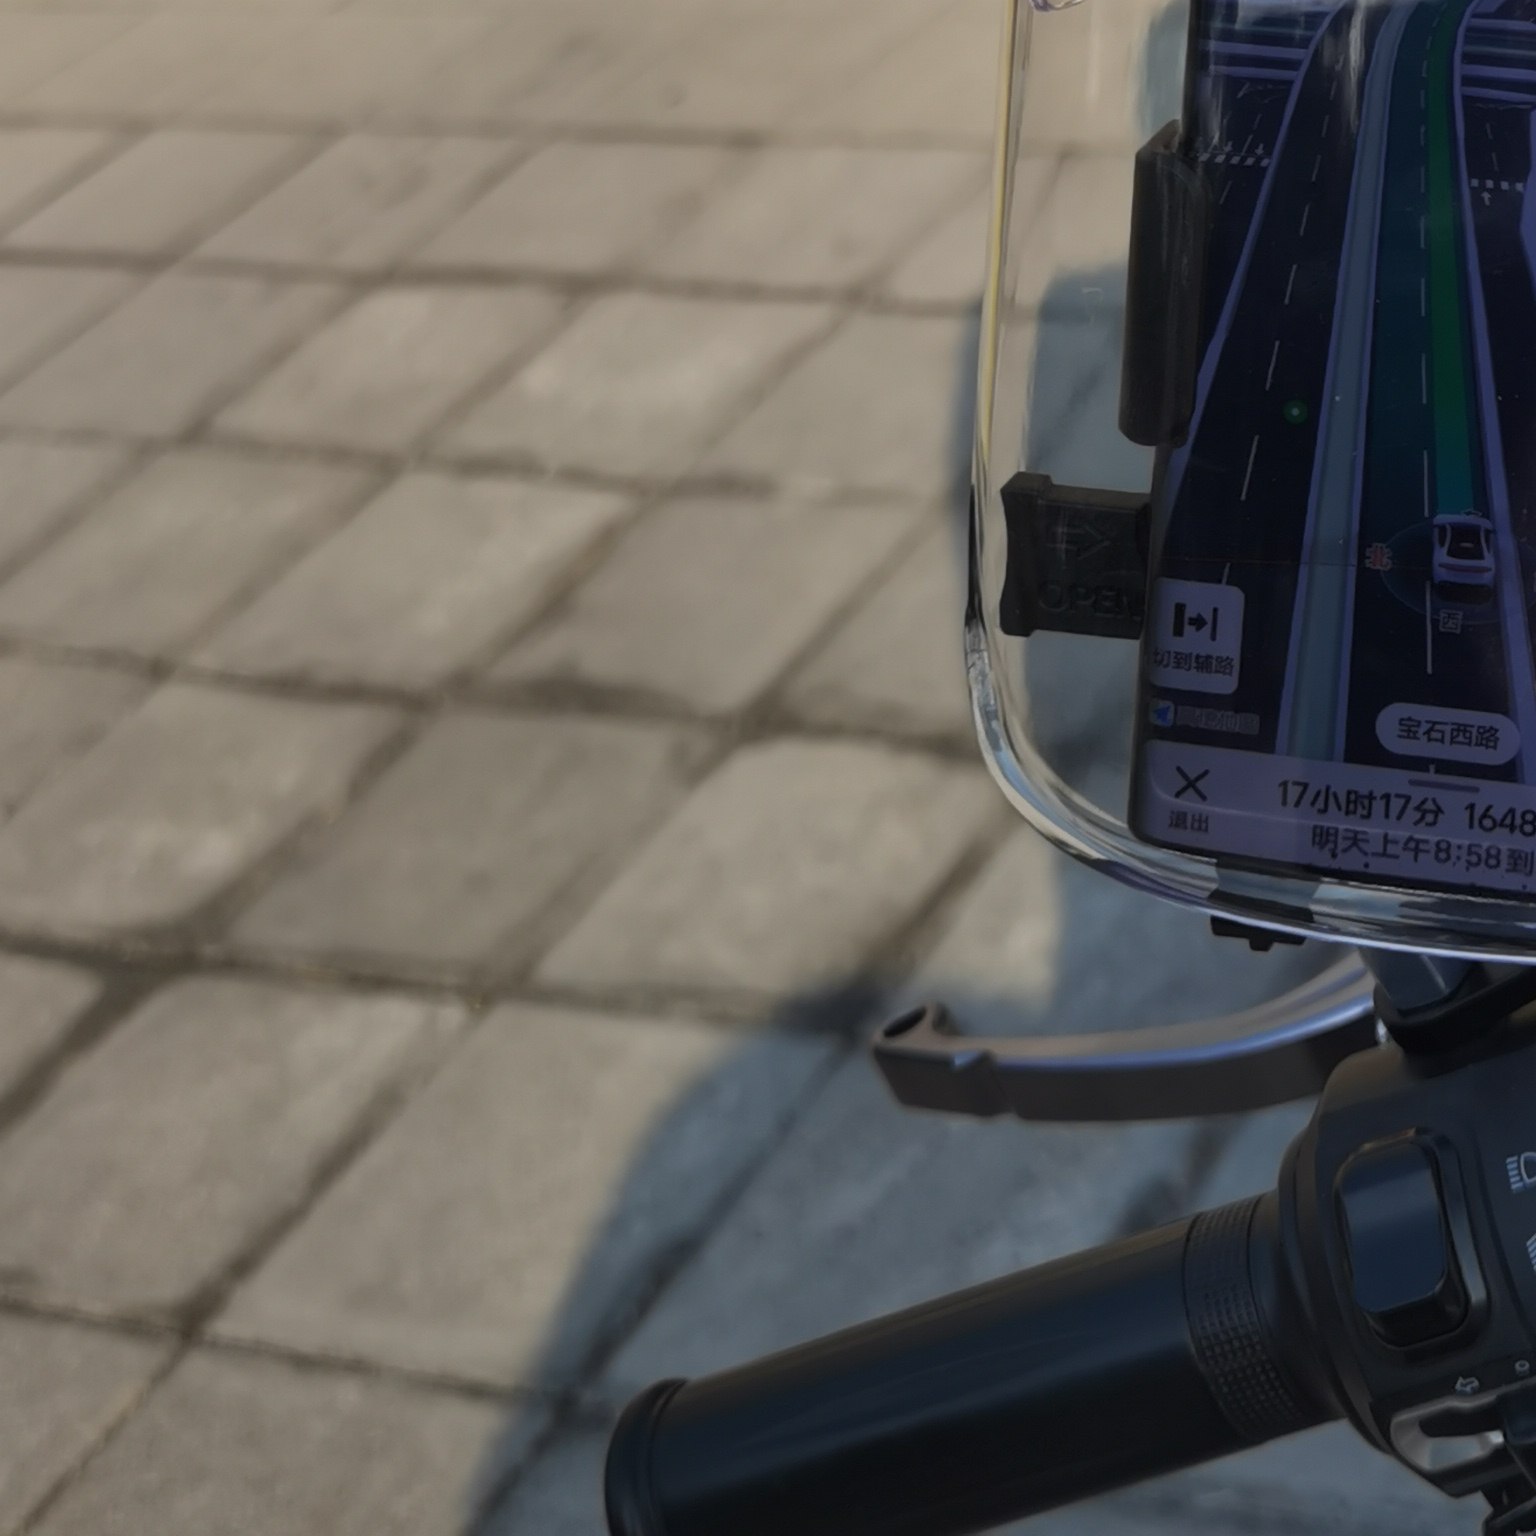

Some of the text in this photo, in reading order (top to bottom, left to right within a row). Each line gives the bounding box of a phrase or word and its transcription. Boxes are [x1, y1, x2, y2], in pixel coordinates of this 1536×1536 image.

[1365, 542, 1393, 571] 北
[1438, 609, 1464, 634] 西
[1397, 716, 1500, 751] 宝石西路
[1277, 780, 1445, 828] 17小时17分
[1168, 810, 1210, 833] 退出
